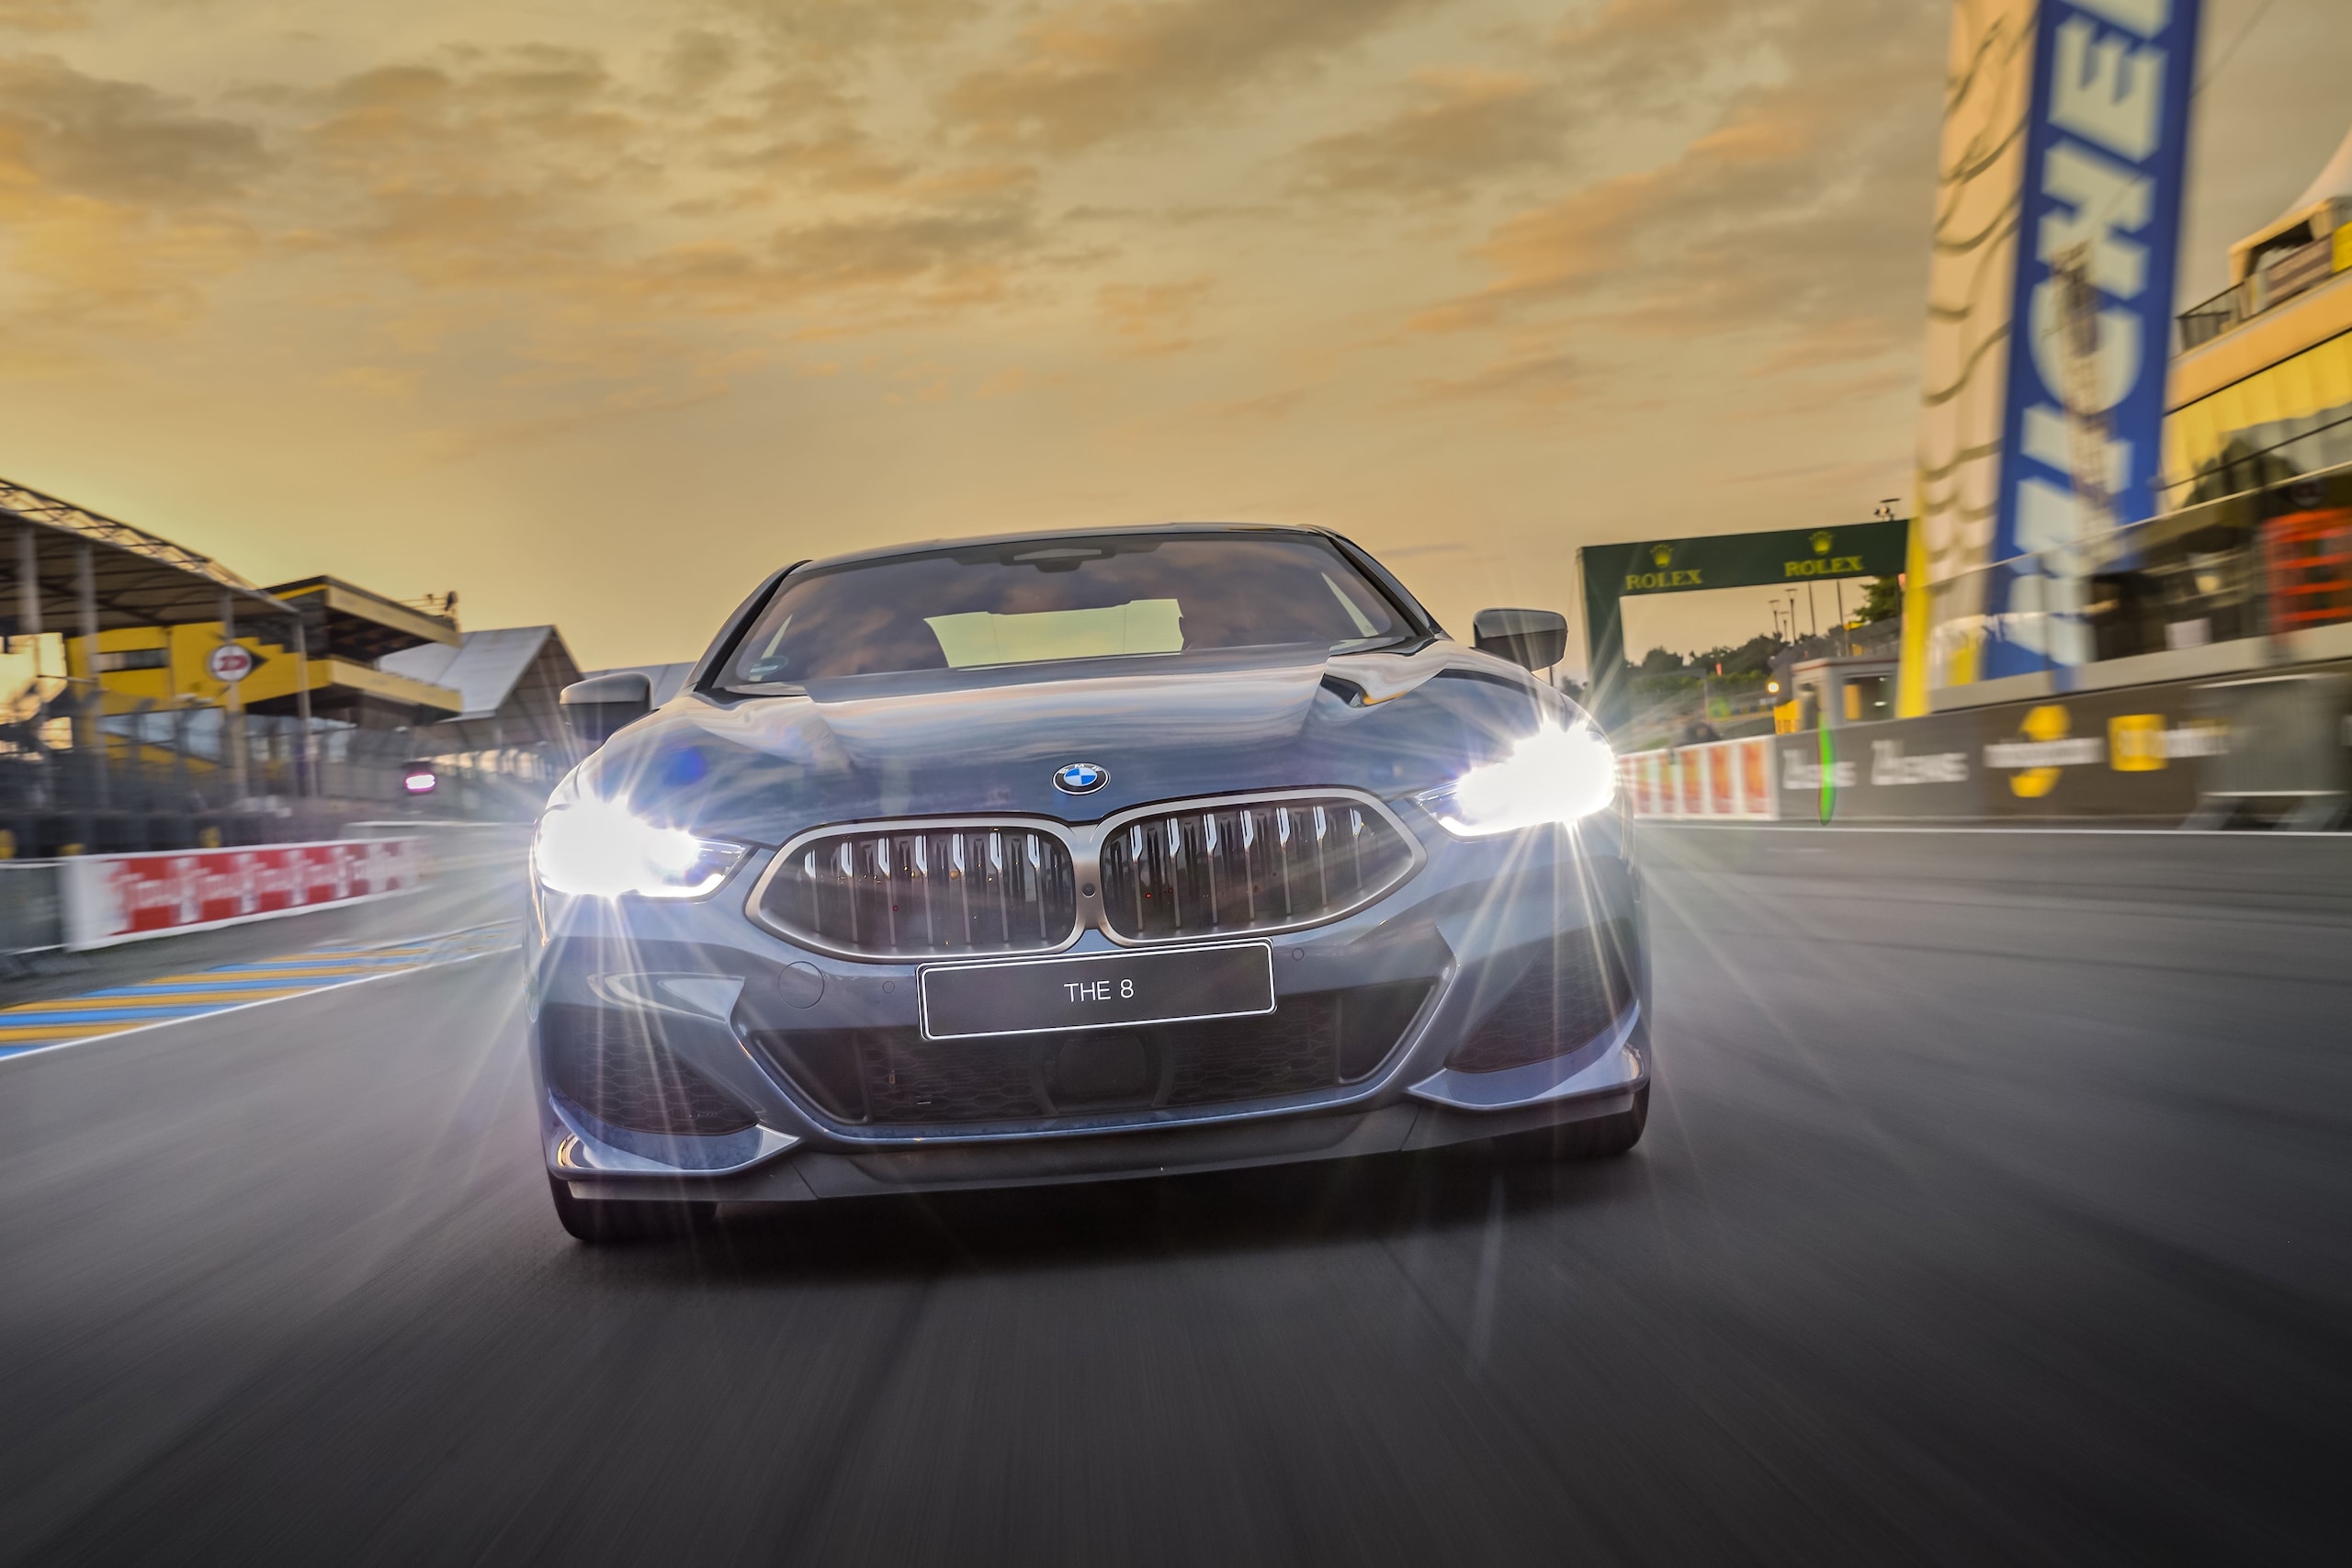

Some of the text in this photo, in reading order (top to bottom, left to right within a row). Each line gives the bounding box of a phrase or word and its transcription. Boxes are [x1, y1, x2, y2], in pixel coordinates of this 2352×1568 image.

[1784, 556, 1863, 577] ROLEX
[1624, 569, 1702, 590] ROLEX
[1057, 763, 1103, 774] BMW
[1063, 978, 1135, 1003] THE 8
